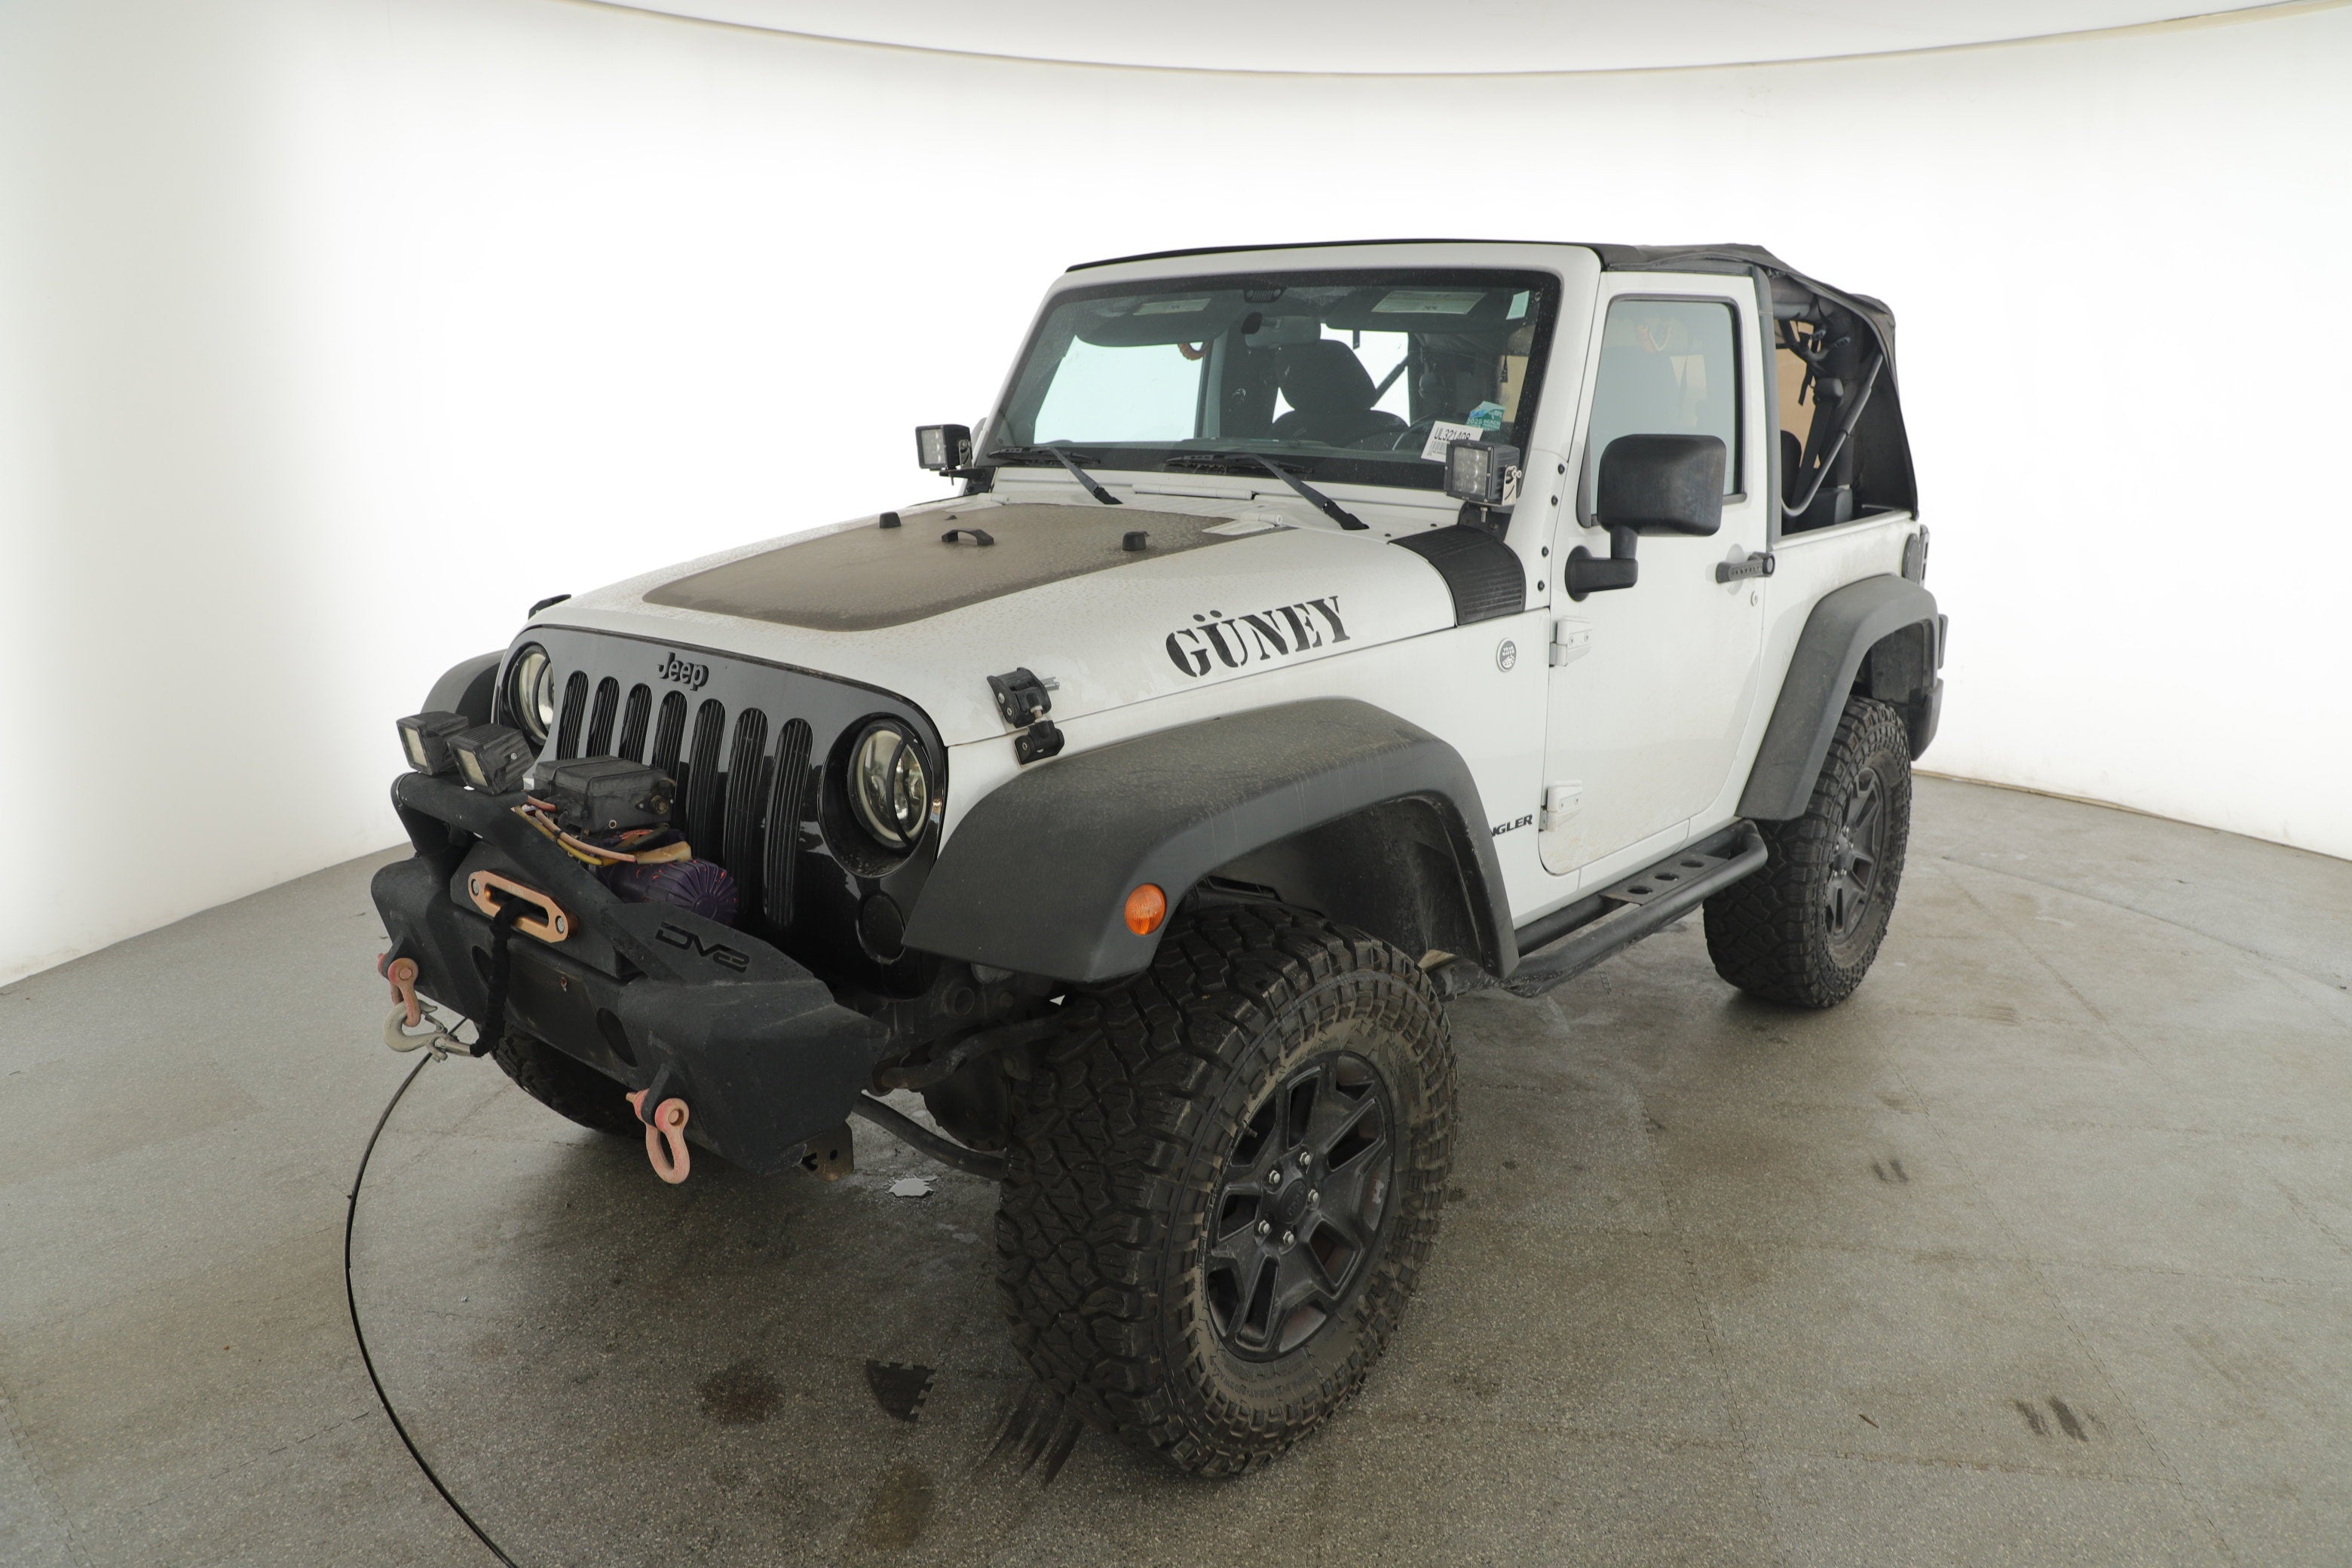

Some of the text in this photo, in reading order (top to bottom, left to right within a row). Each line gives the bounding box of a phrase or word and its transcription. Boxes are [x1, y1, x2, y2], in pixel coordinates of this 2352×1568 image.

[1165, 596, 1351, 677] GÜNEY
[657, 652, 709, 691] Jeep
[1490, 814, 1533, 837] NGLER
